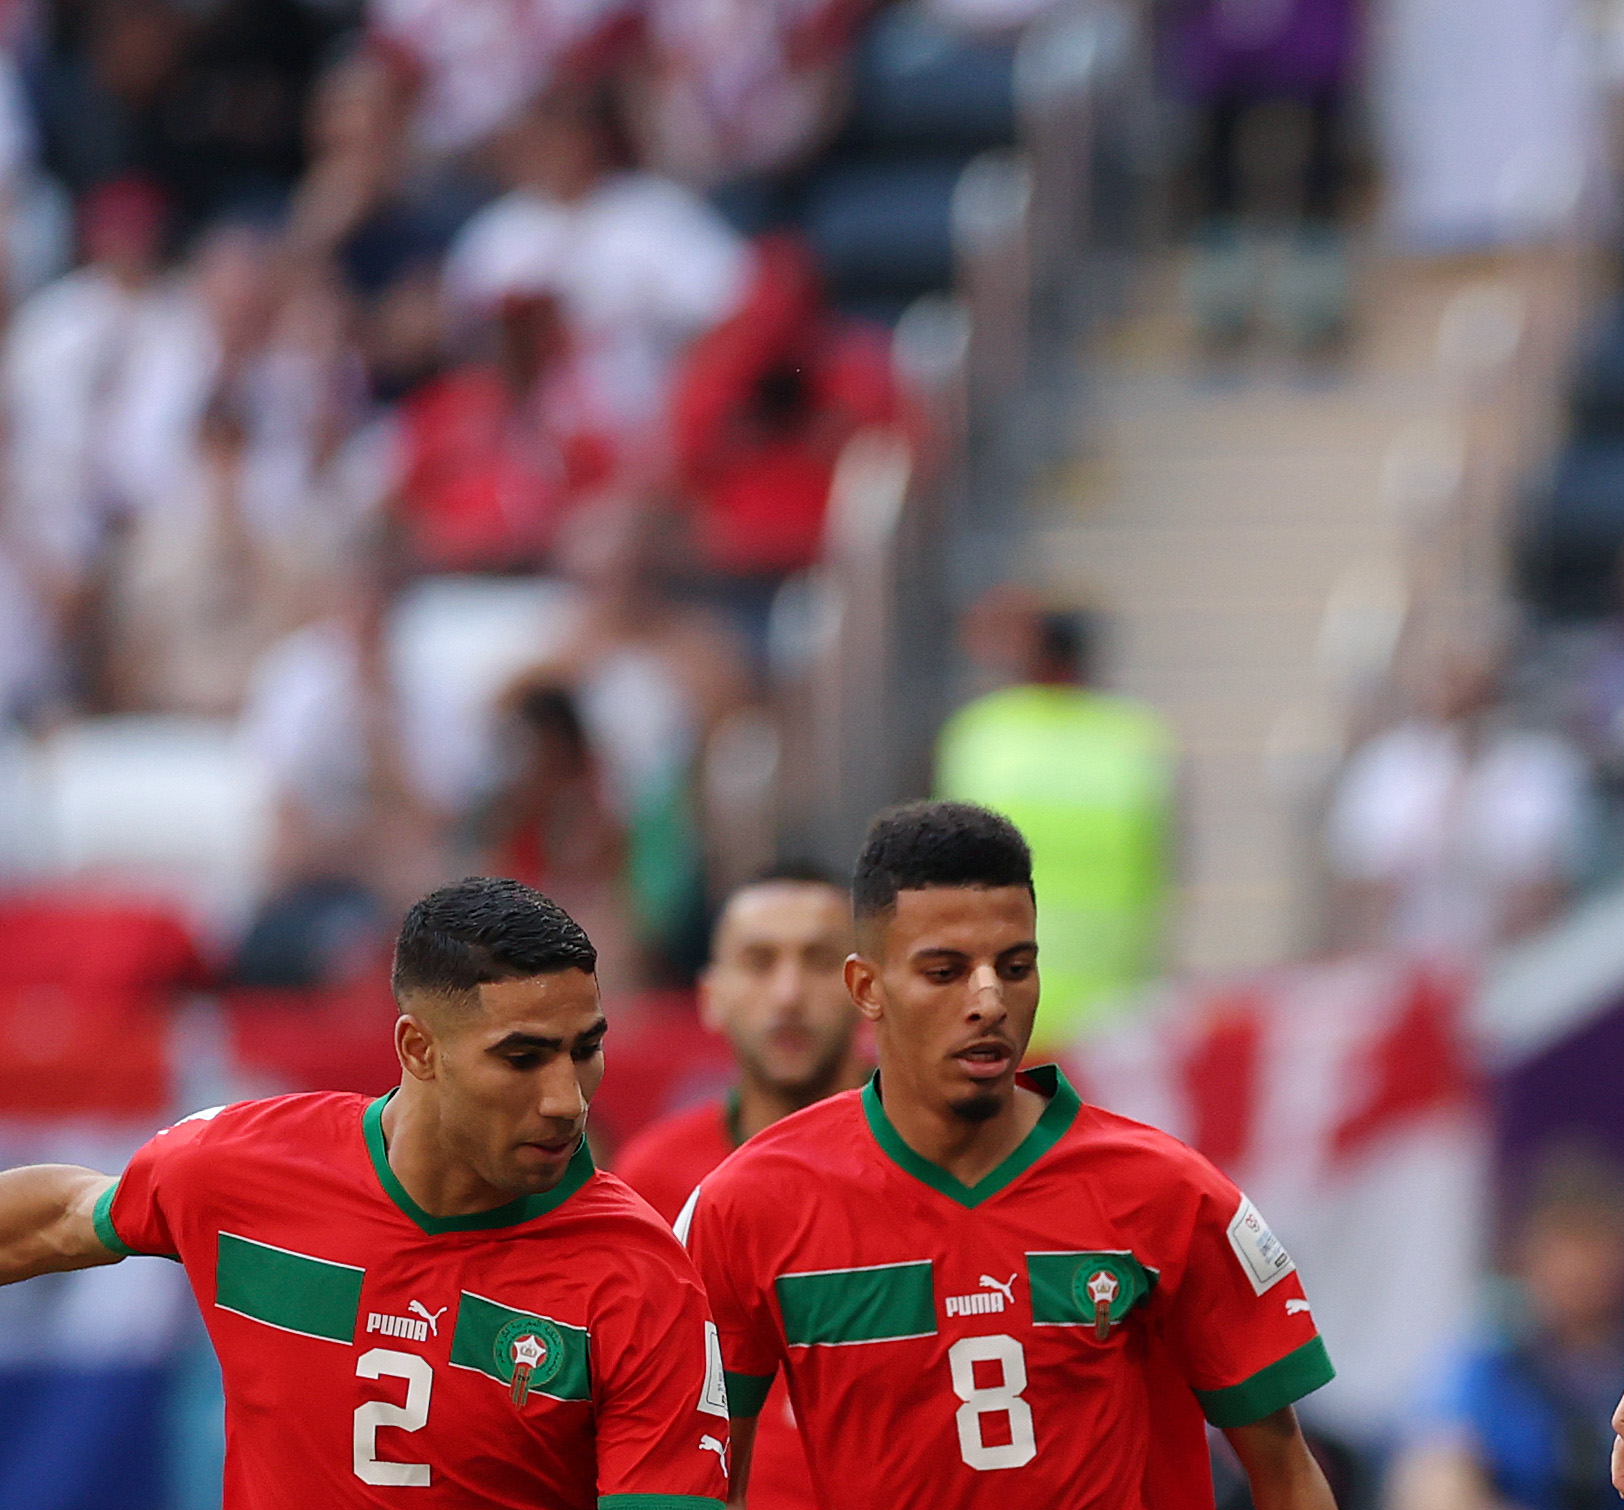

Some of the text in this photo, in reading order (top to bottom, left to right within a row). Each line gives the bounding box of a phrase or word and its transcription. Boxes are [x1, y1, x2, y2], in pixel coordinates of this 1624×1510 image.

[366, 1312, 428, 1342] PUMA
[945, 1292, 1005, 1317] PUMA
[354, 1347, 433, 1487] 2
[948, 1333, 1037, 1471] 8
